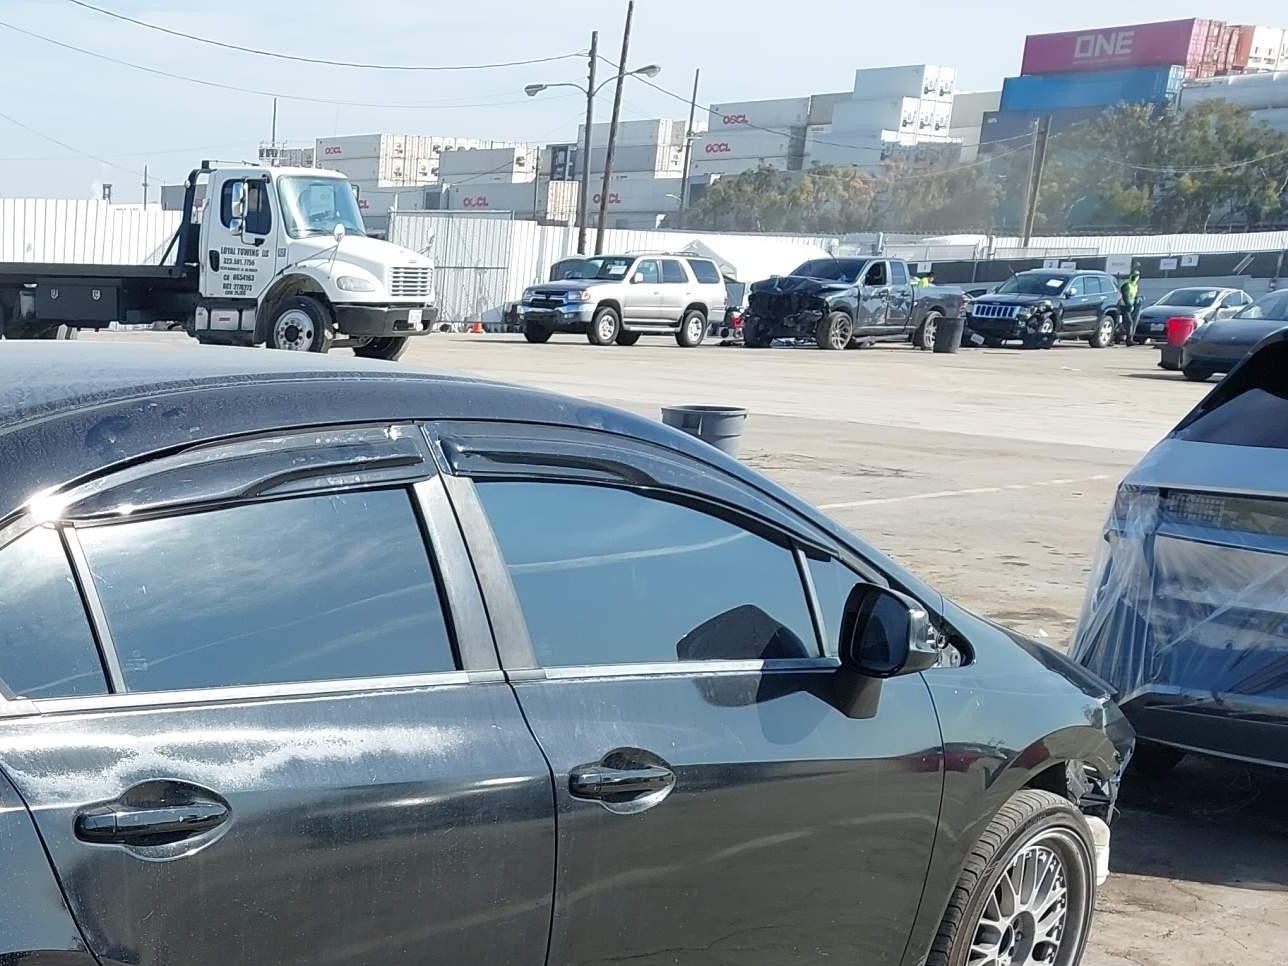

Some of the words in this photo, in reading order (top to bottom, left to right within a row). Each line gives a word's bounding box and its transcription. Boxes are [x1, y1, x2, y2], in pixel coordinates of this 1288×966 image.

[1074, 30, 1134, 58] ONE
[220, 247, 236, 255] LOYAL
[237, 248, 259, 257] TOWING
